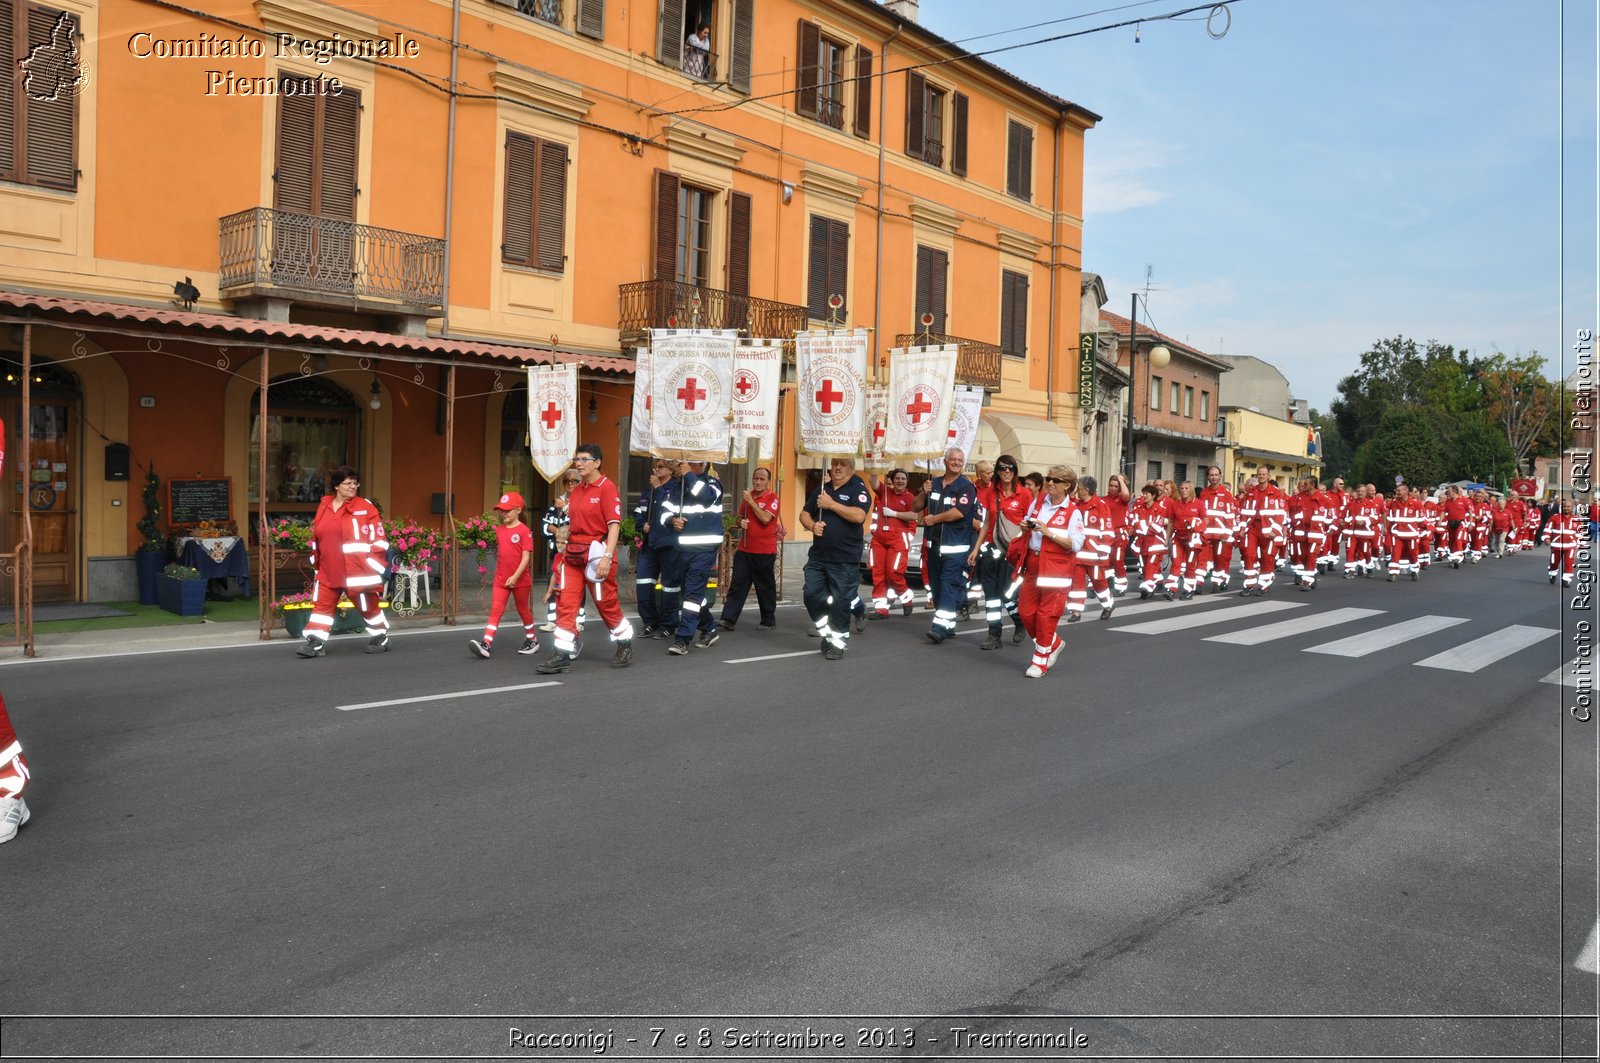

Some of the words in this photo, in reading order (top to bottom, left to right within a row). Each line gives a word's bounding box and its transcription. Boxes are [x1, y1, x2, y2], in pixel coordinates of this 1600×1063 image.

[1081, 335, 1093, 372] ANTICO
[811, 355, 838, 368] ROSSA
[839, 360, 866, 393] ITALIANA
[1080, 374, 1093, 406] FORNO
[37, 490, 48, 504] R
